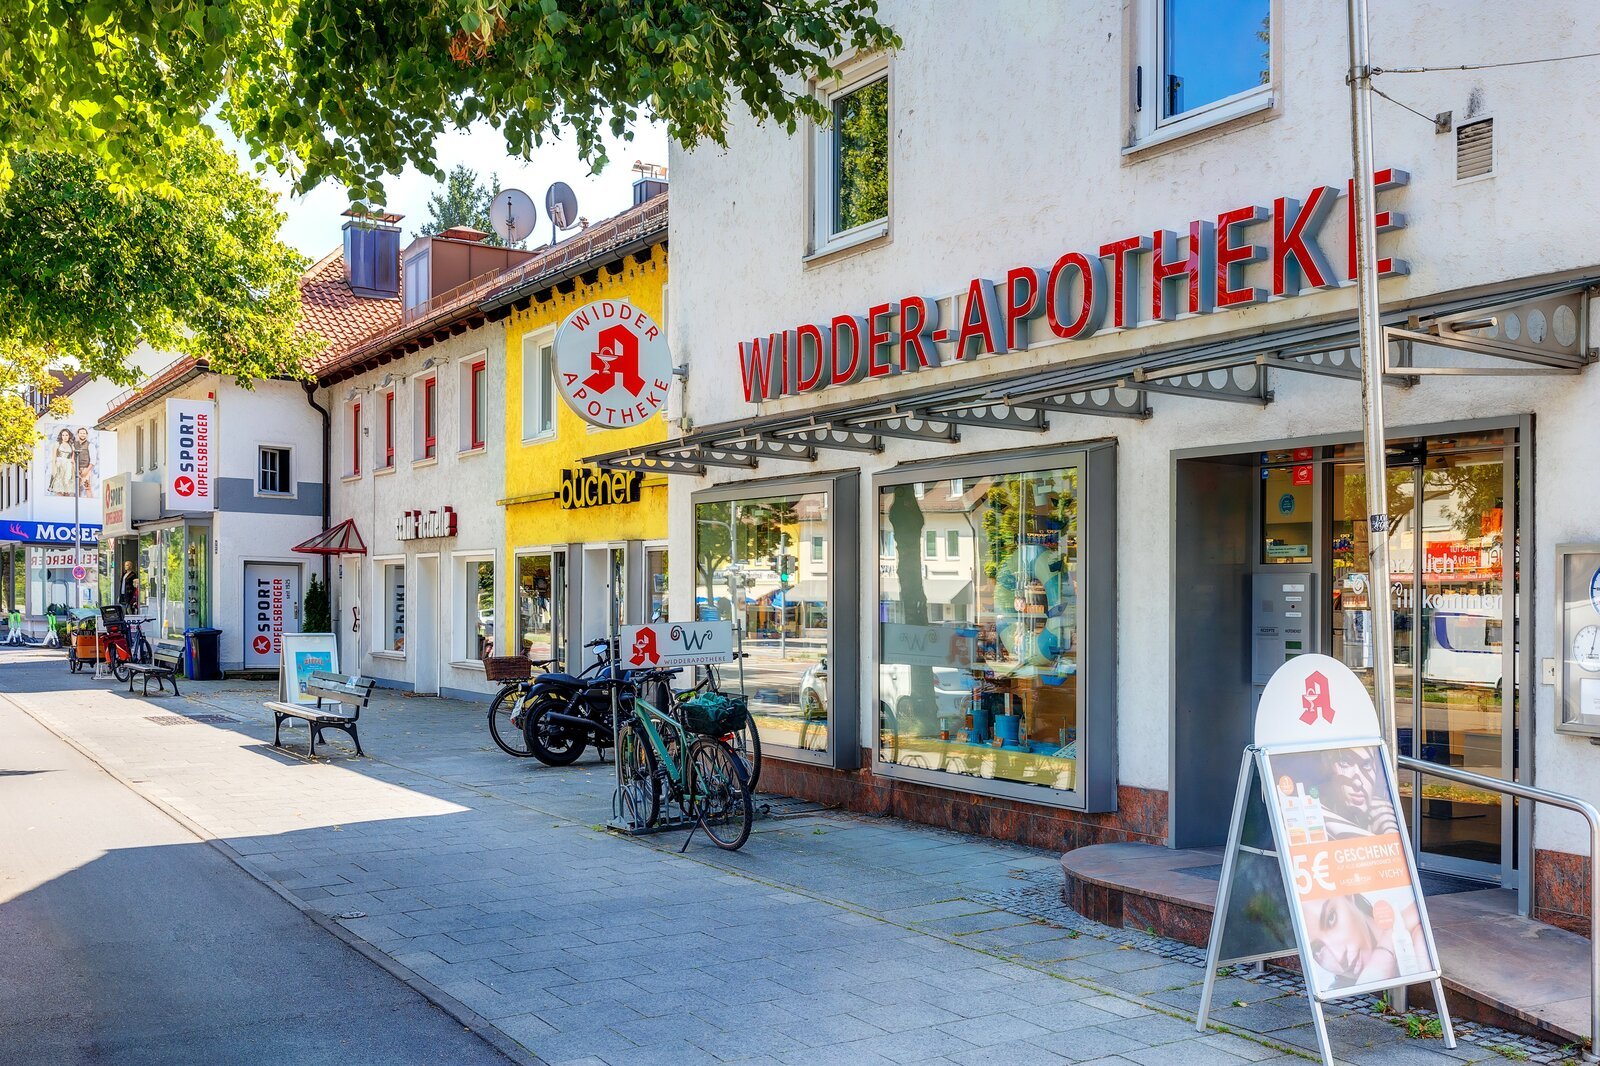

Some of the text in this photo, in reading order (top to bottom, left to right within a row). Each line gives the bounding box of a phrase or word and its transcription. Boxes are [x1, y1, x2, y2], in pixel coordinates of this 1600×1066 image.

[738, 168, 1408, 403] WIDDER-APOTHEKE
[571, 302, 659, 342] WIDDER
[562, 378, 669, 424] APOTHEKE
[180, 412, 194, 472] SPORT
[197, 413, 208, 497] KIPFELSBERGER
[560, 467, 638, 509] bücher
[258, 578, 270, 632] SPORT
[273, 578, 283, 654] KIPFELSBERGER
[663, 656, 726, 665] WIDDERAPOTHEKE
[1293, 851, 1337, 895] 5€
[1334, 842, 1401, 864] GESCHENKT
[1378, 867, 1404, 880] VICHY
